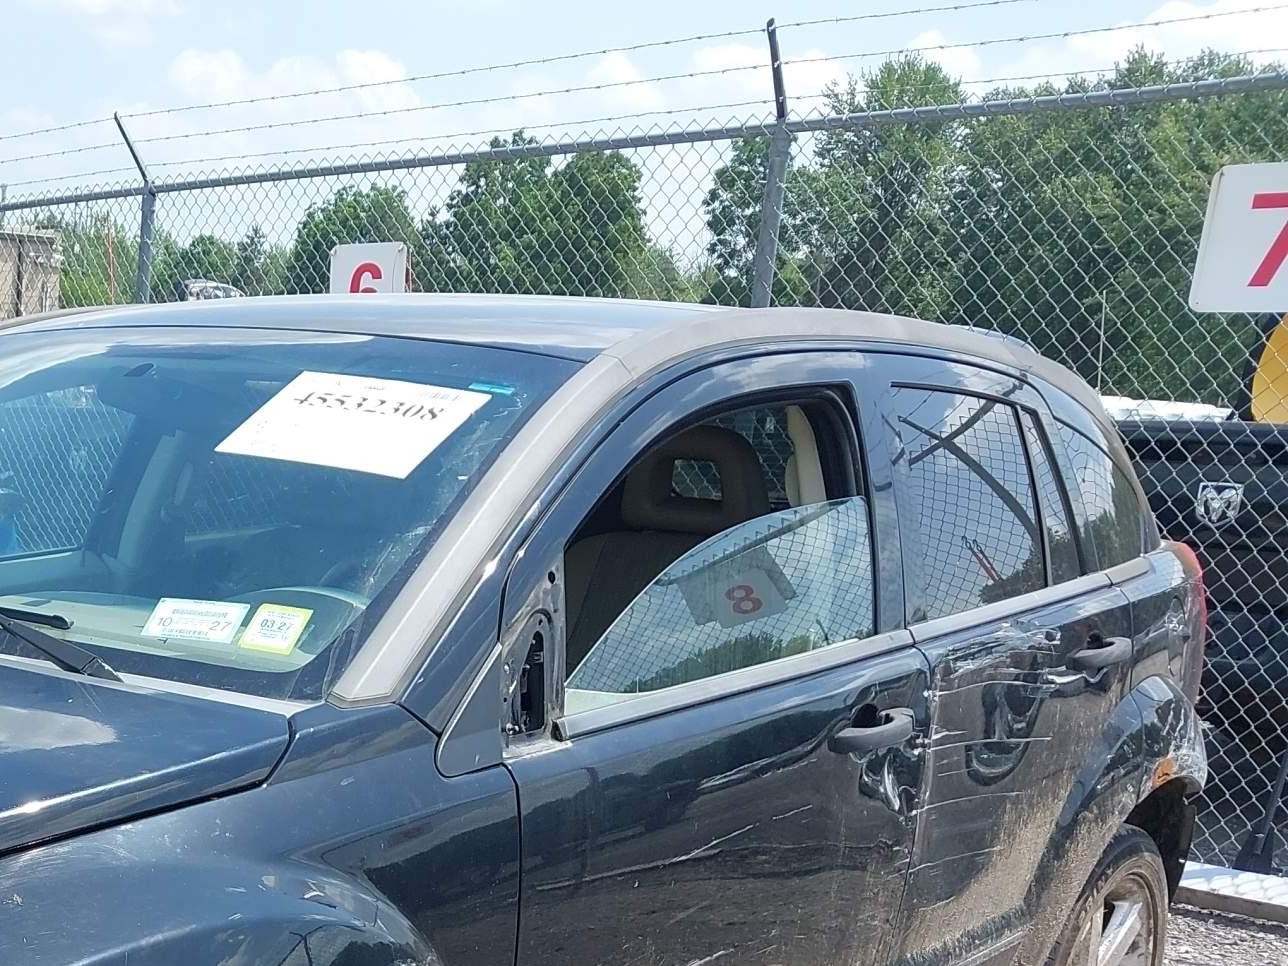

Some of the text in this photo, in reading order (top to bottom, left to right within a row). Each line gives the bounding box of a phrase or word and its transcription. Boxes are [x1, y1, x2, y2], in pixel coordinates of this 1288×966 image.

[1247, 192, 1288, 288] 7
[293, 391, 447, 421] 45532308
[157, 615, 233, 632] 10 27
